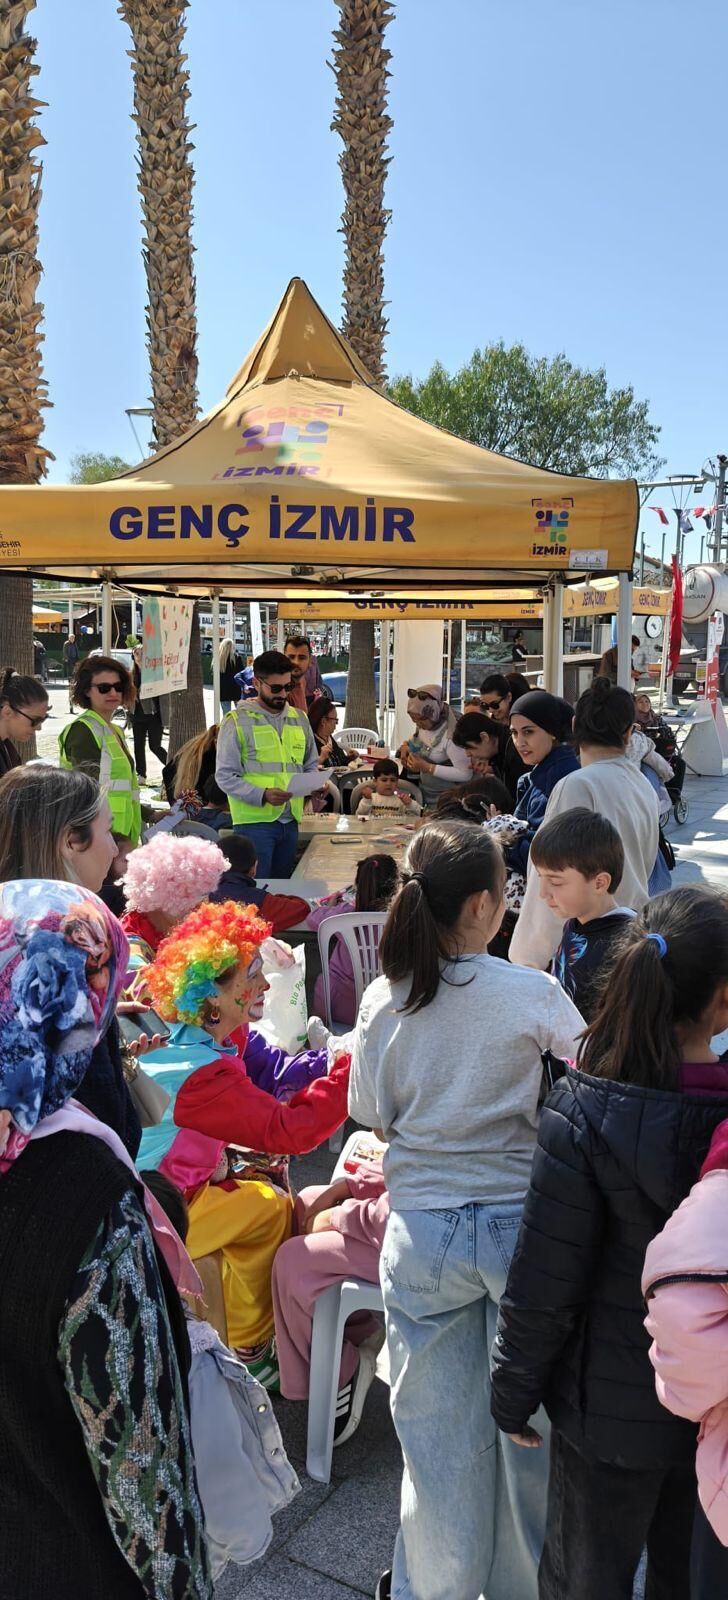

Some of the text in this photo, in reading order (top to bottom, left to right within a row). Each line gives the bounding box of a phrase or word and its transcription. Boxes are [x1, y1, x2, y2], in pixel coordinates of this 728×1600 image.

[223, 463, 320, 477] İZMİR
[109, 495, 416, 548] GENÇ İZMİR
[532, 543, 567, 555] İZMİR
